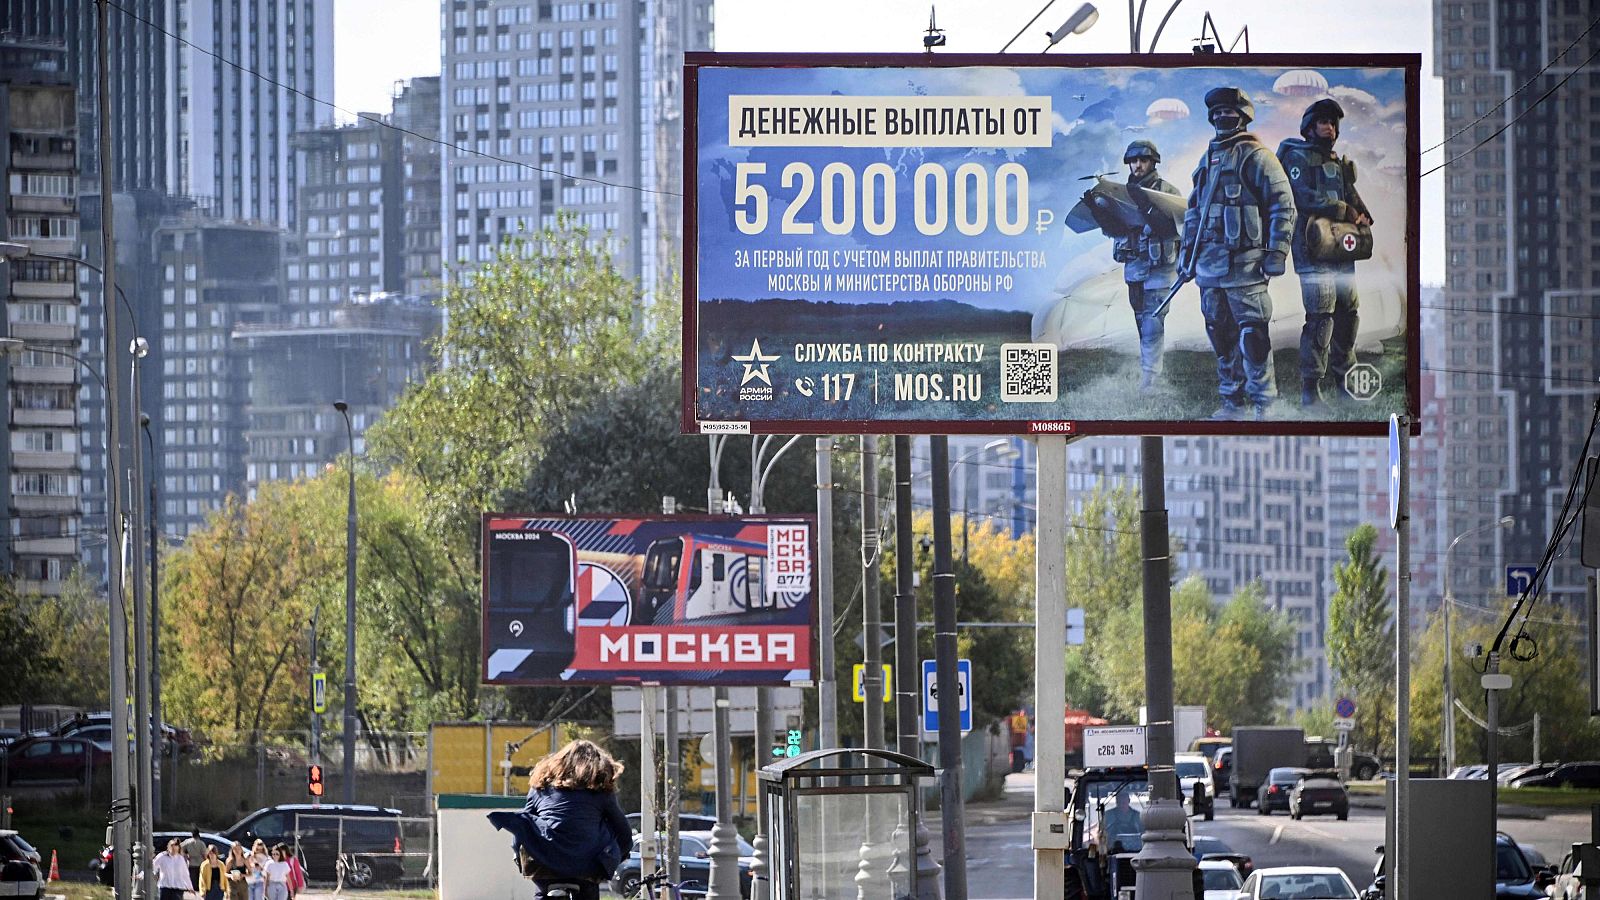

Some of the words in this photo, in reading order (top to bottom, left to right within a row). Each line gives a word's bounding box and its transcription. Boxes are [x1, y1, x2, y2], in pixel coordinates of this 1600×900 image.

[739, 107, 877, 138] ДЕНЕЖНЫЕ
[885, 107, 1005, 135] ВЫПЛАТЫ
[1013, 107, 1042, 135] ОТ
[734, 162, 769, 236] 5
[781, 161, 897, 236] 200
[914, 162, 1029, 236] 000
[734, 250, 750, 268] ЗА
[753, 247, 803, 268] ПЕРВЫЙ
[807, 250, 830, 271] ГОД
[833, 250, 841, 268] С
[843, 250, 890, 268] УЧЕТОМ
[894, 250, 943, 268] ВЫПЛАТ
[947, 250, 1047, 269] ПРАВИТЕЛЬСТВА
[768, 274, 820, 292] МОСКВЫ
[824, 274, 832, 292] И
[836, 274, 930, 292] МИНИСТЕРСТВА
[933, 274, 991, 292] ОБОРОНЫ
[995, 274, 1013, 292] РФ
[794, 343, 863, 363] СЛУЖБА
[868, 343, 888, 363] ПО
[893, 343, 985, 363] КОНТРАКТУ
[821, 373, 855, 401] 117
[894, 373, 982, 401] MOS.RU
[1350, 370, 1379, 394] 18+
[600, 633, 796, 663] МОСКВА
[1120, 744, 1134, 755] 394
